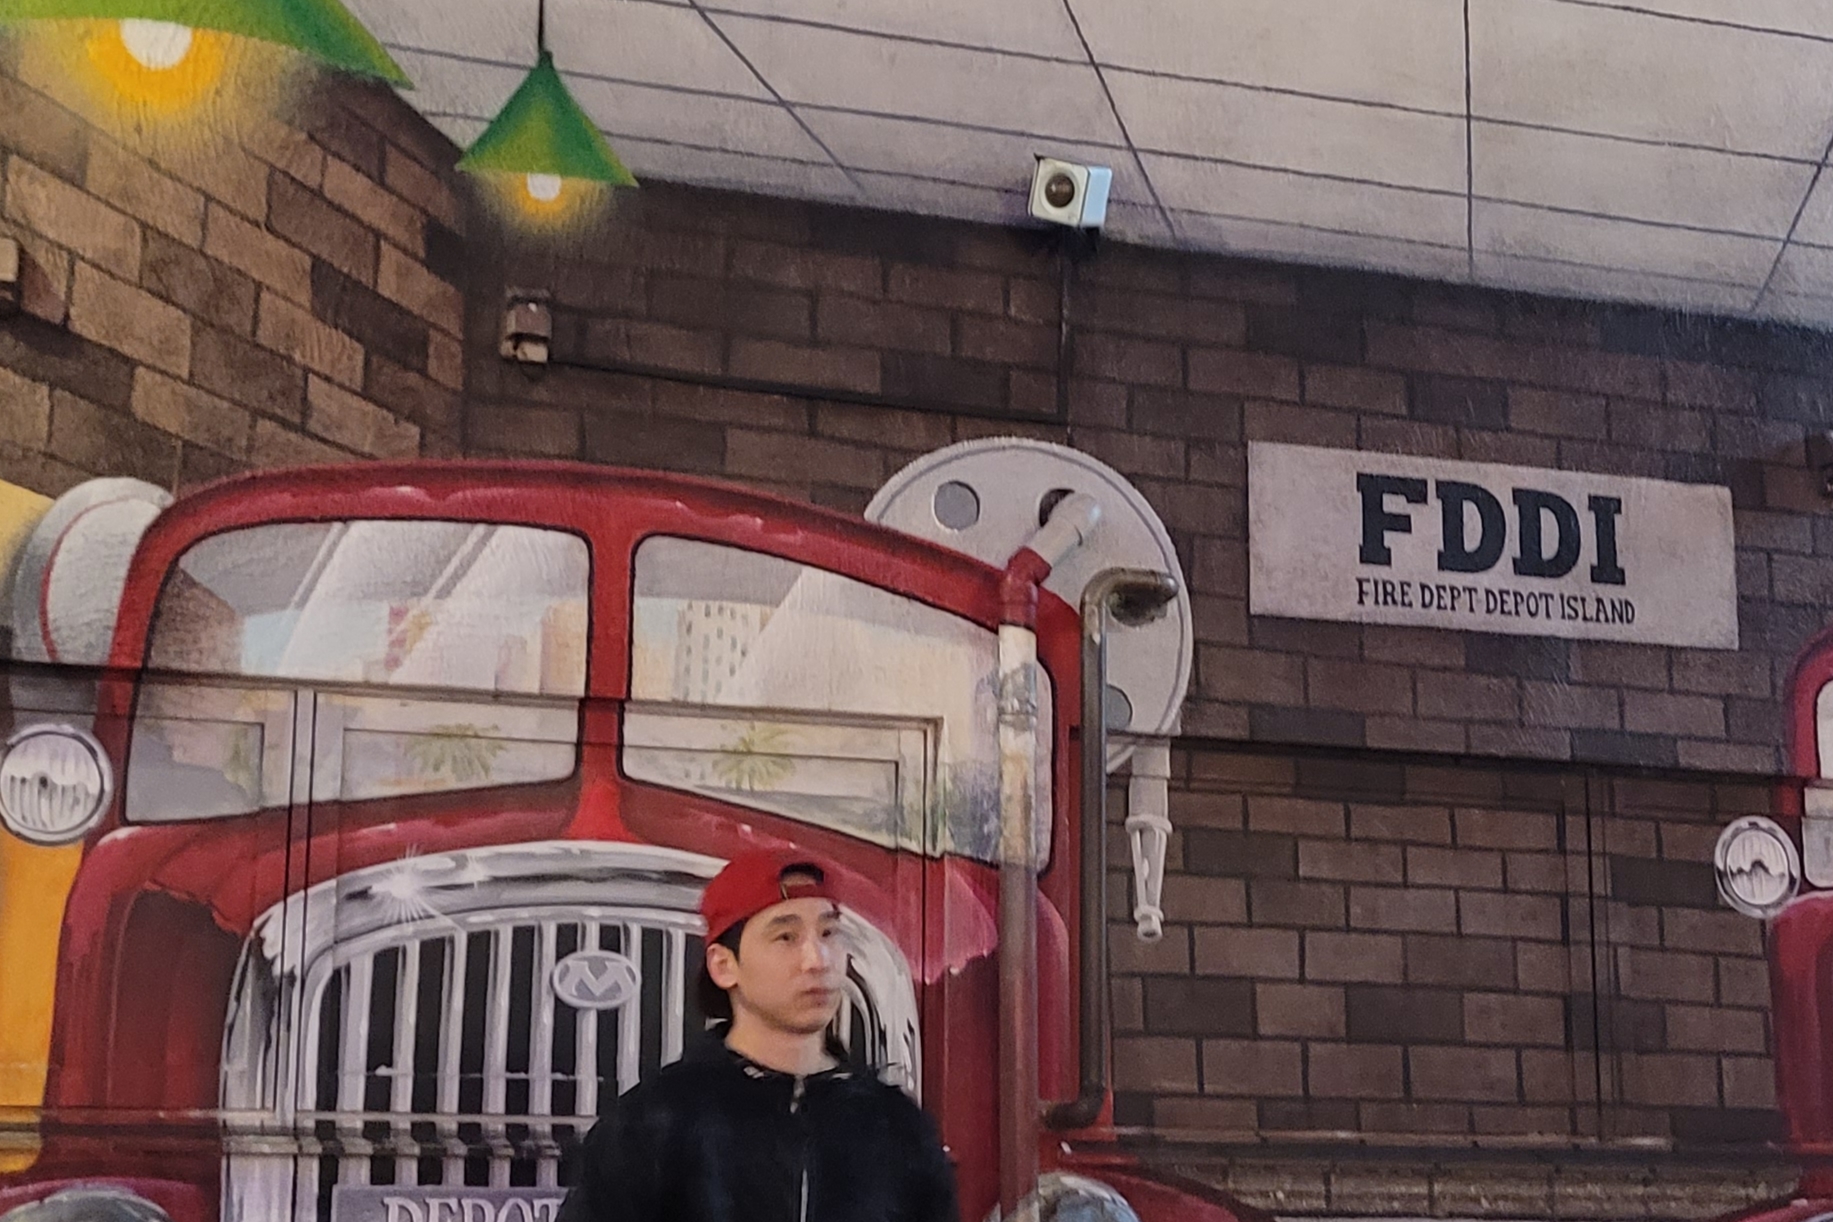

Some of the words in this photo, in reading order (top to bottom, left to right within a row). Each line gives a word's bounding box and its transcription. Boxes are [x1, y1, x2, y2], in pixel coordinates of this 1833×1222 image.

[1355, 471, 1627, 586] FDDI
[1355, 577, 1414, 609] FIRE
[1419, 582, 1480, 614] DEPT
[1484, 587, 1556, 620] DEPOT
[1559, 593, 1637, 625] ISLAND
